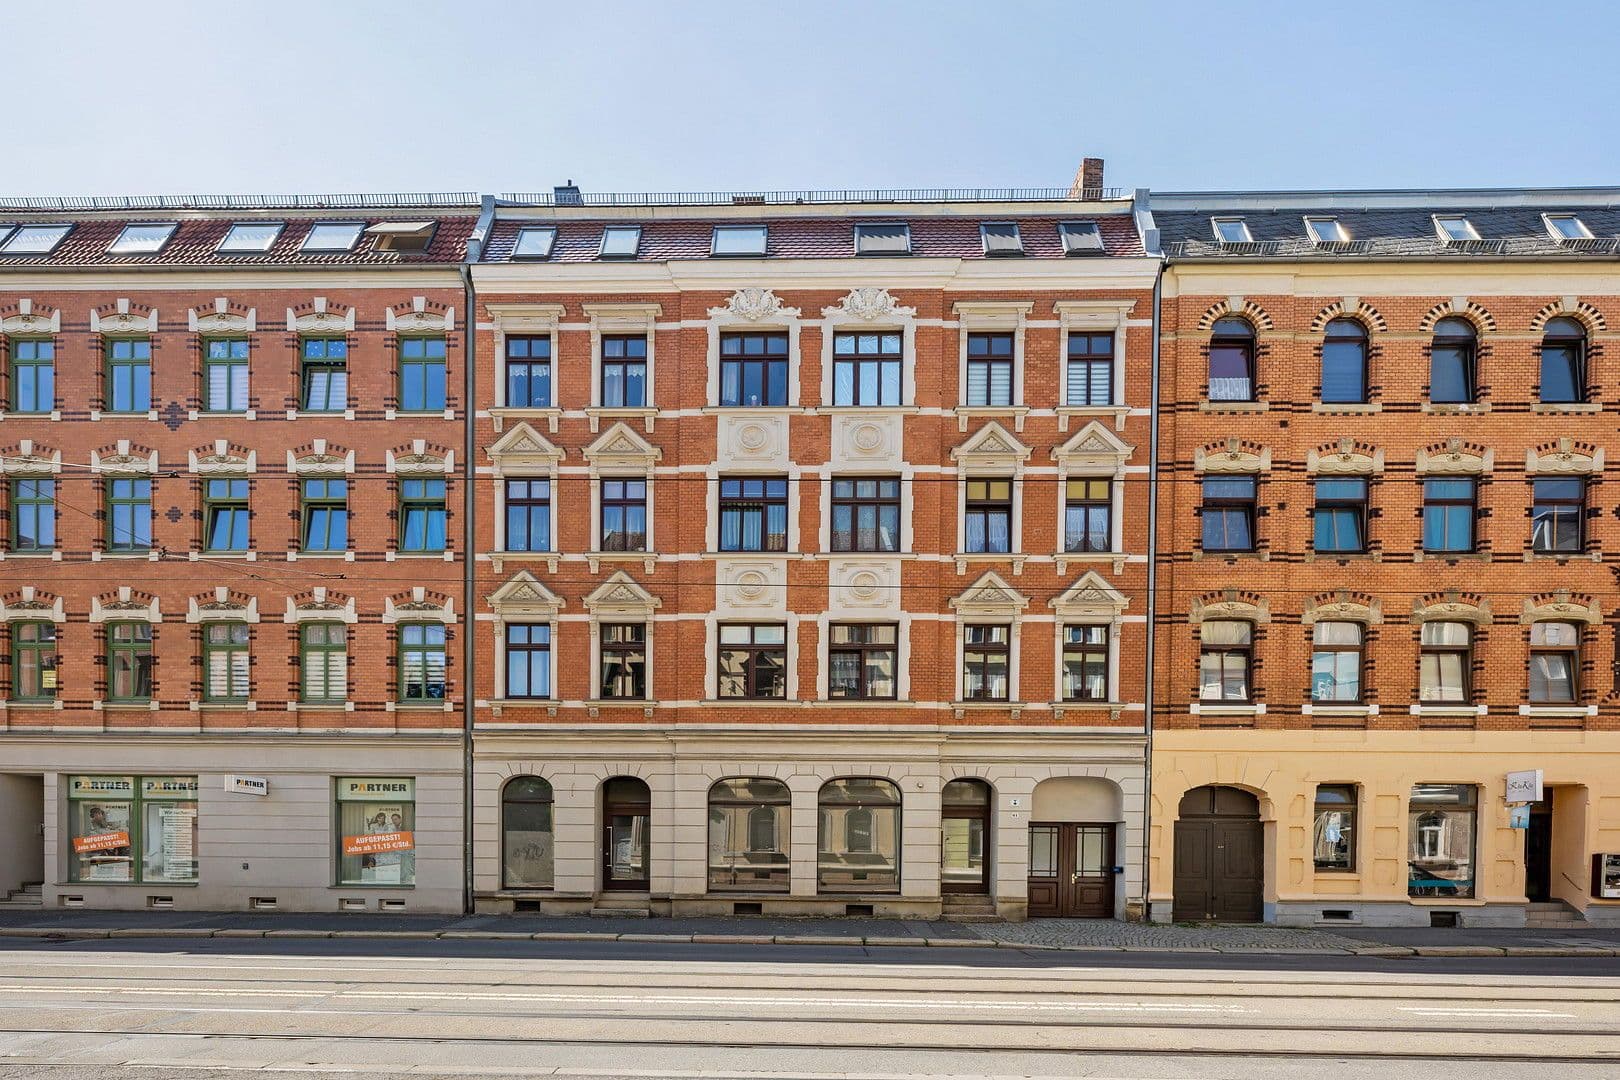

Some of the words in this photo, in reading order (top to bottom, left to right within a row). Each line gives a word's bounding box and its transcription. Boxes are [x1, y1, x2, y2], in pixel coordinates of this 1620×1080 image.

[75, 781, 130, 790] PARTNER
[236, 779, 264, 788] PARTNER
[350, 783, 407, 792] PARTNER
[83, 834, 119, 843] AUFGEPASST!
[355, 833, 401, 845] AUFGEPASST!
[347, 845, 362, 853] Jobs
[373, 842, 391, 850] 11,15
